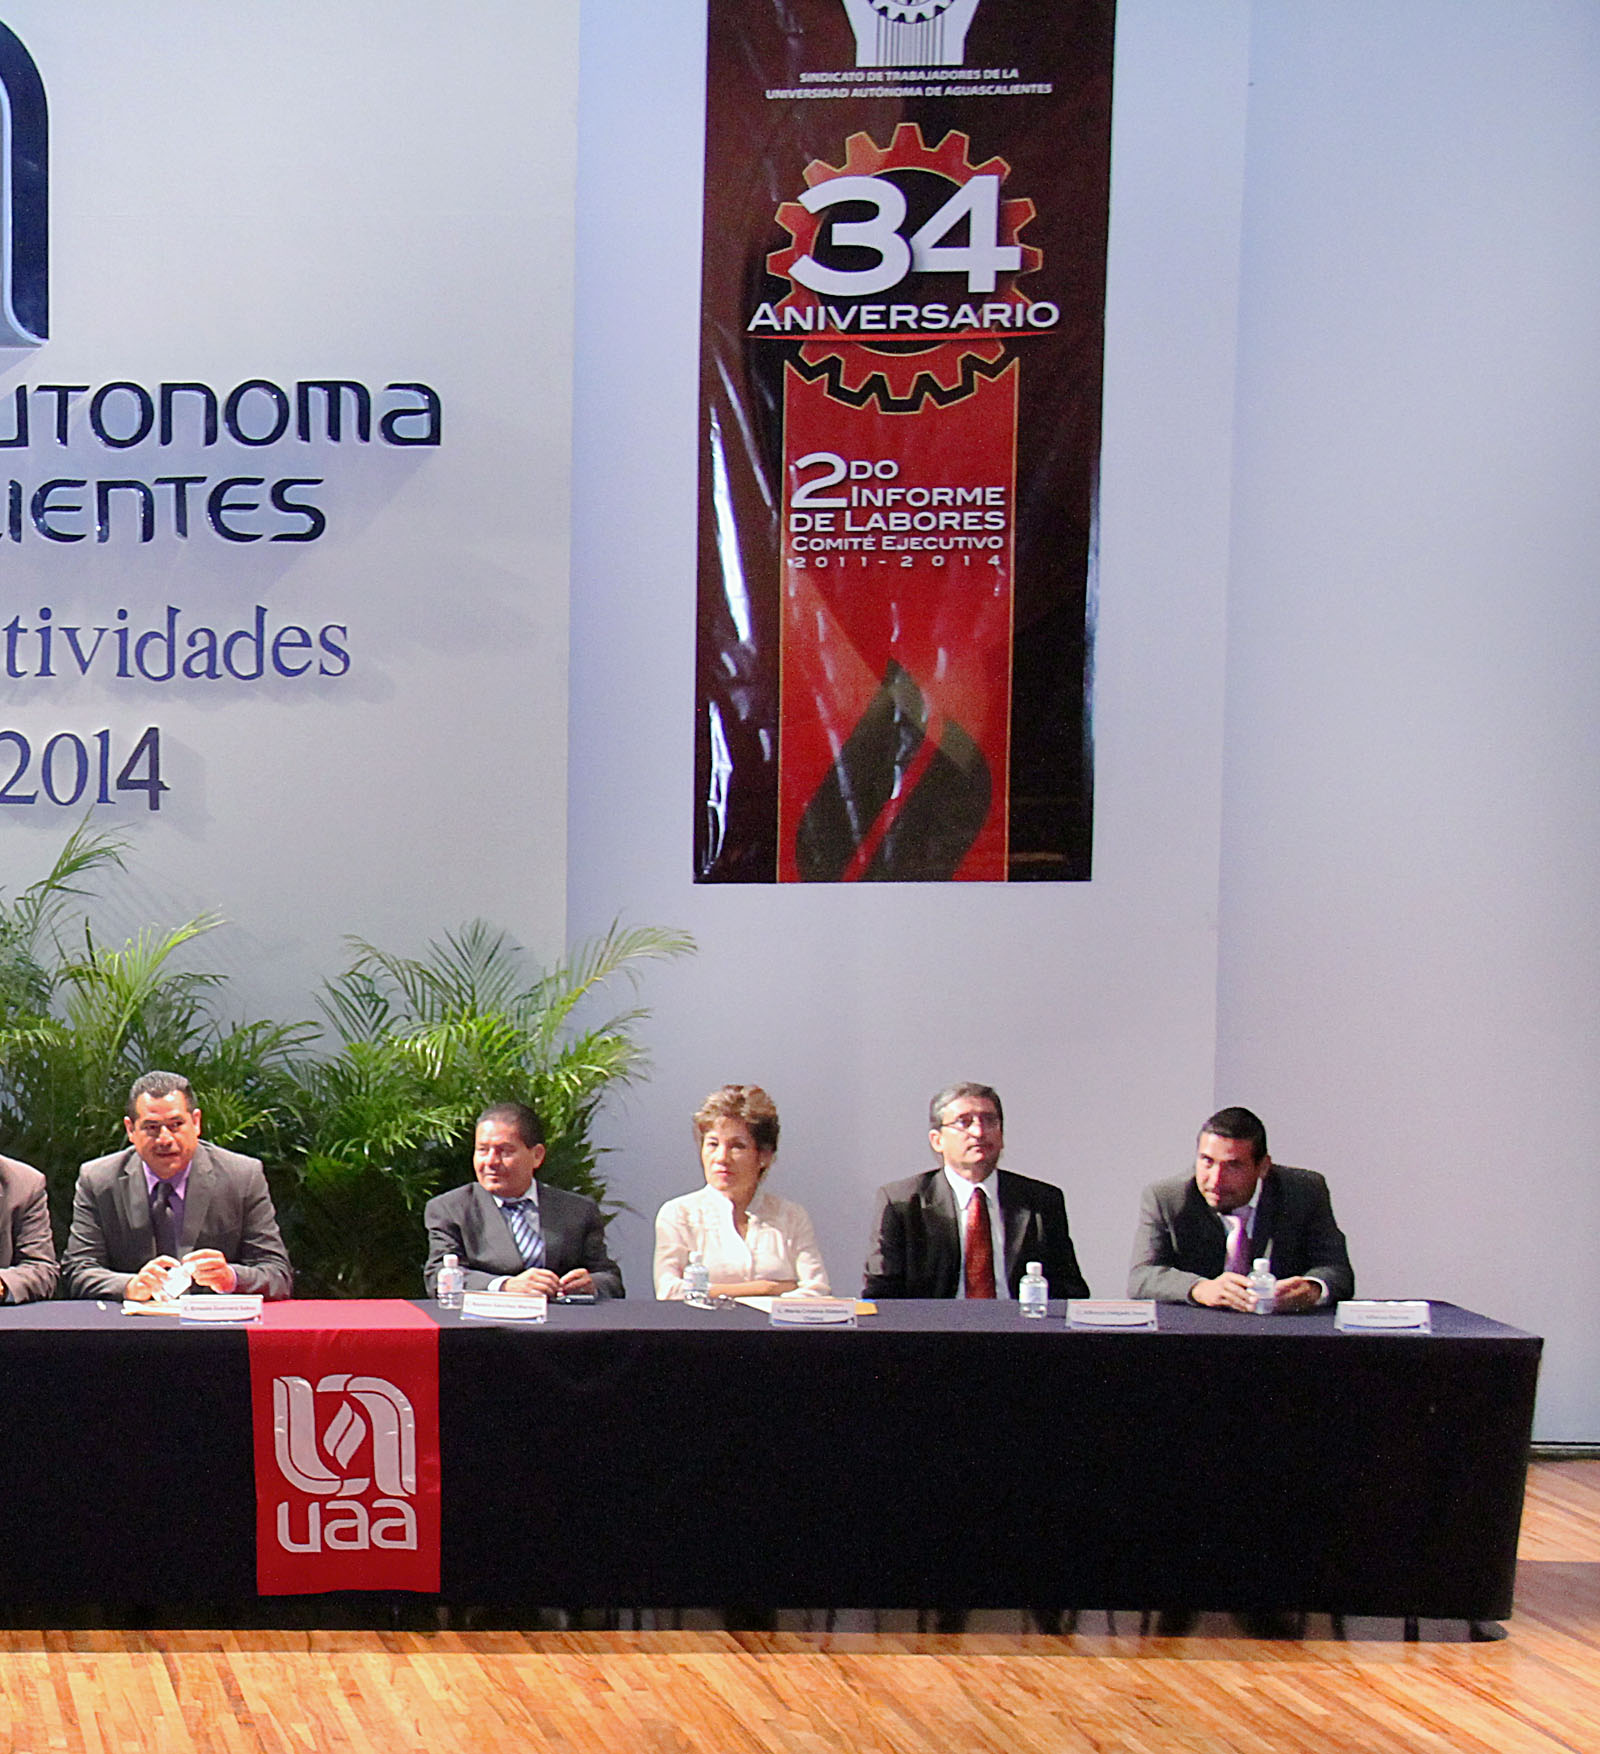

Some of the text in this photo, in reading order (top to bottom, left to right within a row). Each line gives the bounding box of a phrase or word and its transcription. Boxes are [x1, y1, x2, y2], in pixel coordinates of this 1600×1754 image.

[800, 69, 1019, 83] SINDICATO DE TRABAJADORES DE LA
[765, 88, 849, 100] UNIVERSIDAD
[925, 87, 942, 97] DE
[943, 84, 1052, 96] AGUASCALIENTES
[788, 175, 1022, 297] 34
[746, 301, 1060, 332] ANIVERSARIO
[851, 486, 1006, 507] INFORME
[789, 510, 1006, 533] DE LABORES
[791, 534, 1004, 552] COMITÉ EJECUTIVO
